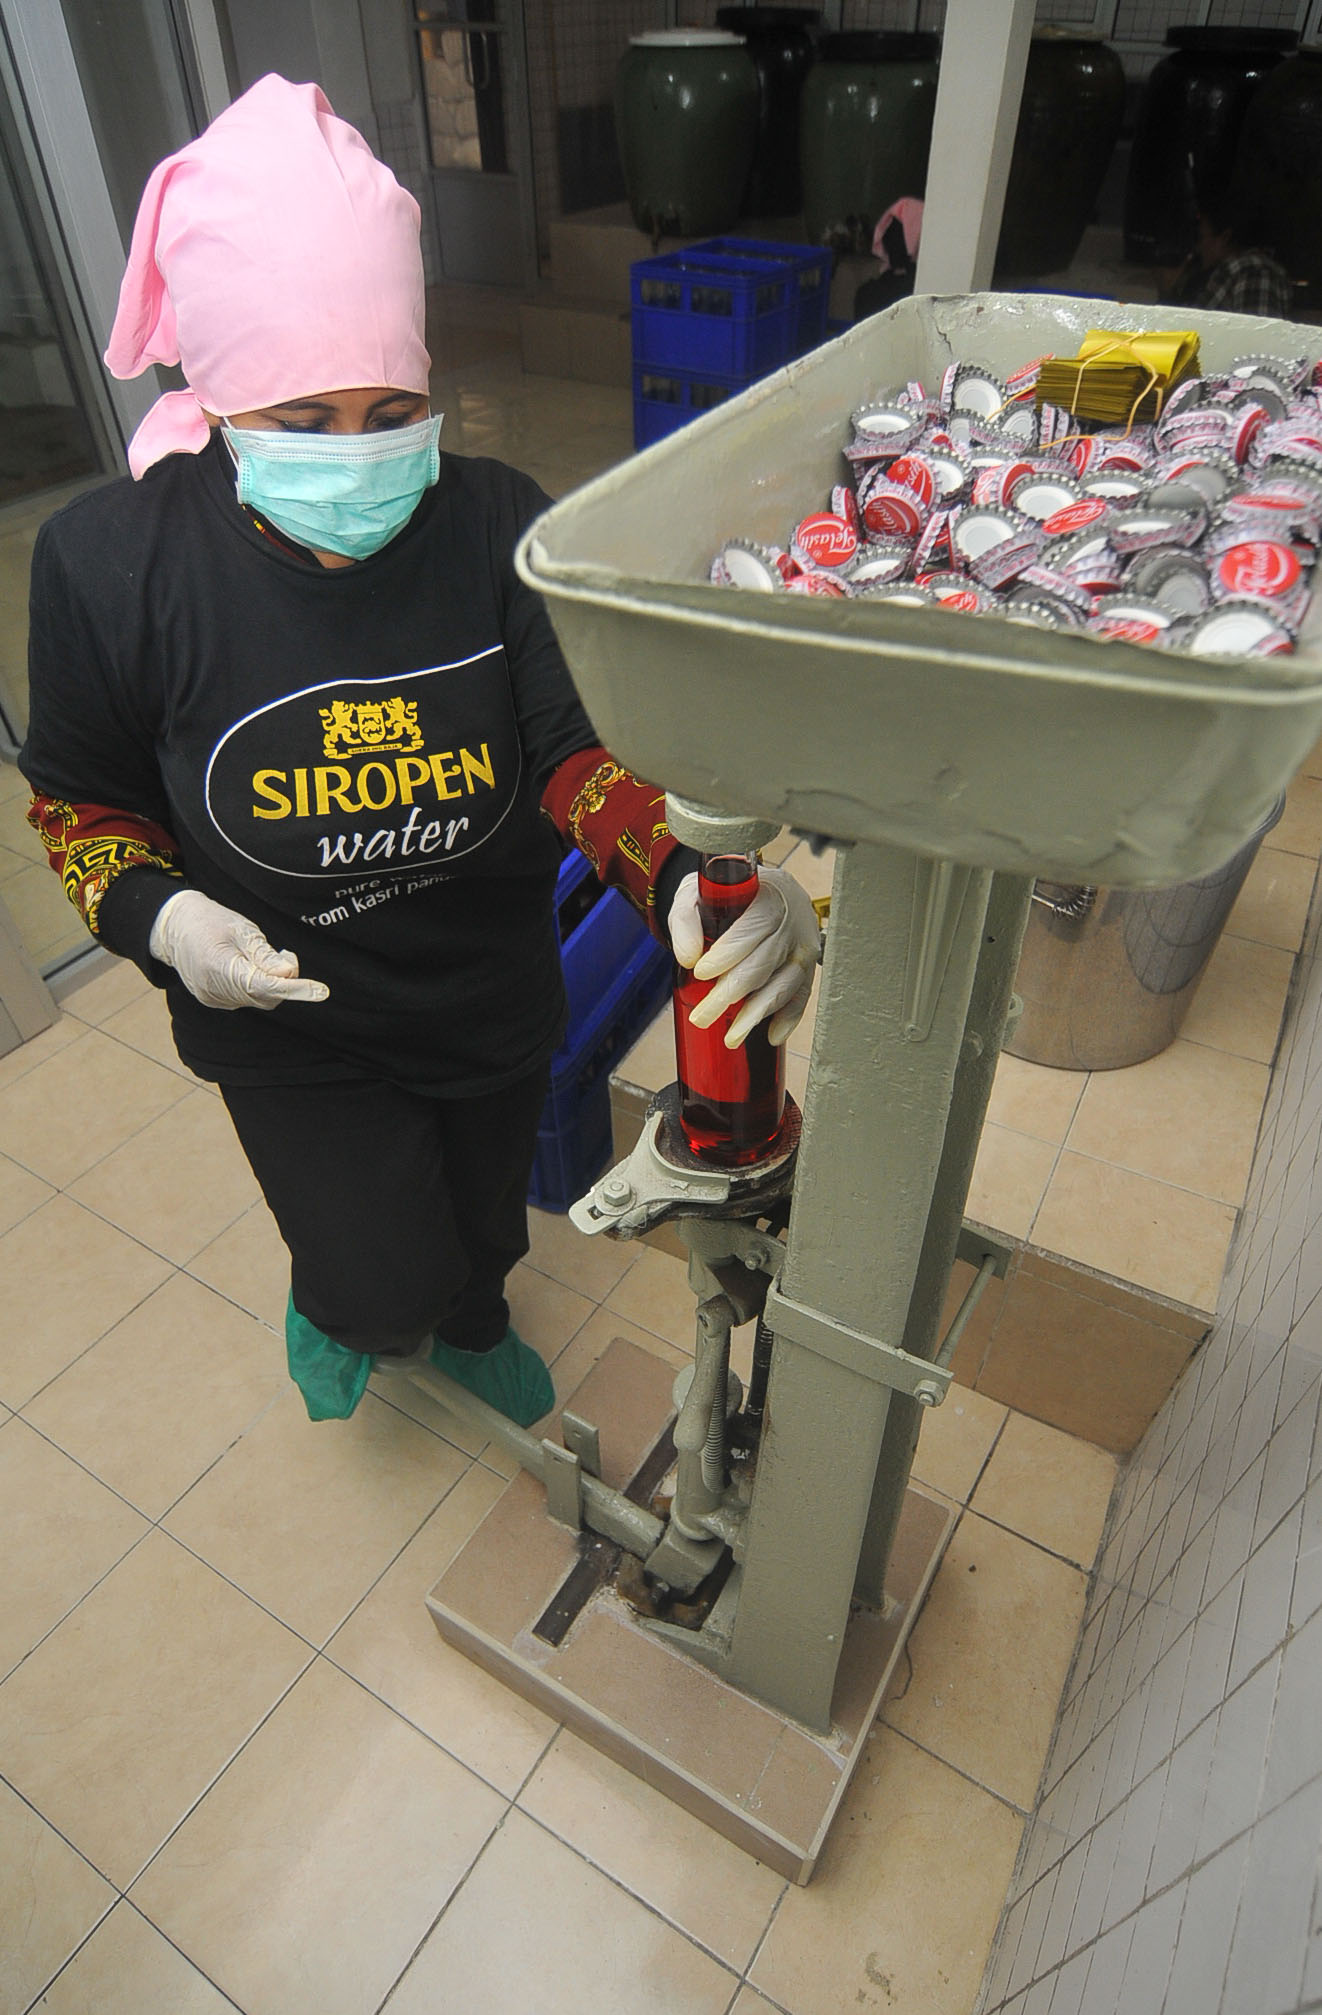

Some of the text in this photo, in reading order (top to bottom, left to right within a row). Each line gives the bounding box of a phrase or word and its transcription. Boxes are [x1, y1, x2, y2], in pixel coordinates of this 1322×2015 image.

[799, 521, 857, 554] Telasih
[252, 743, 496, 820] SIROPEN
[316, 806, 469, 868] water
[335, 879, 381, 898] pure
[351, 884, 399, 913] kasri
